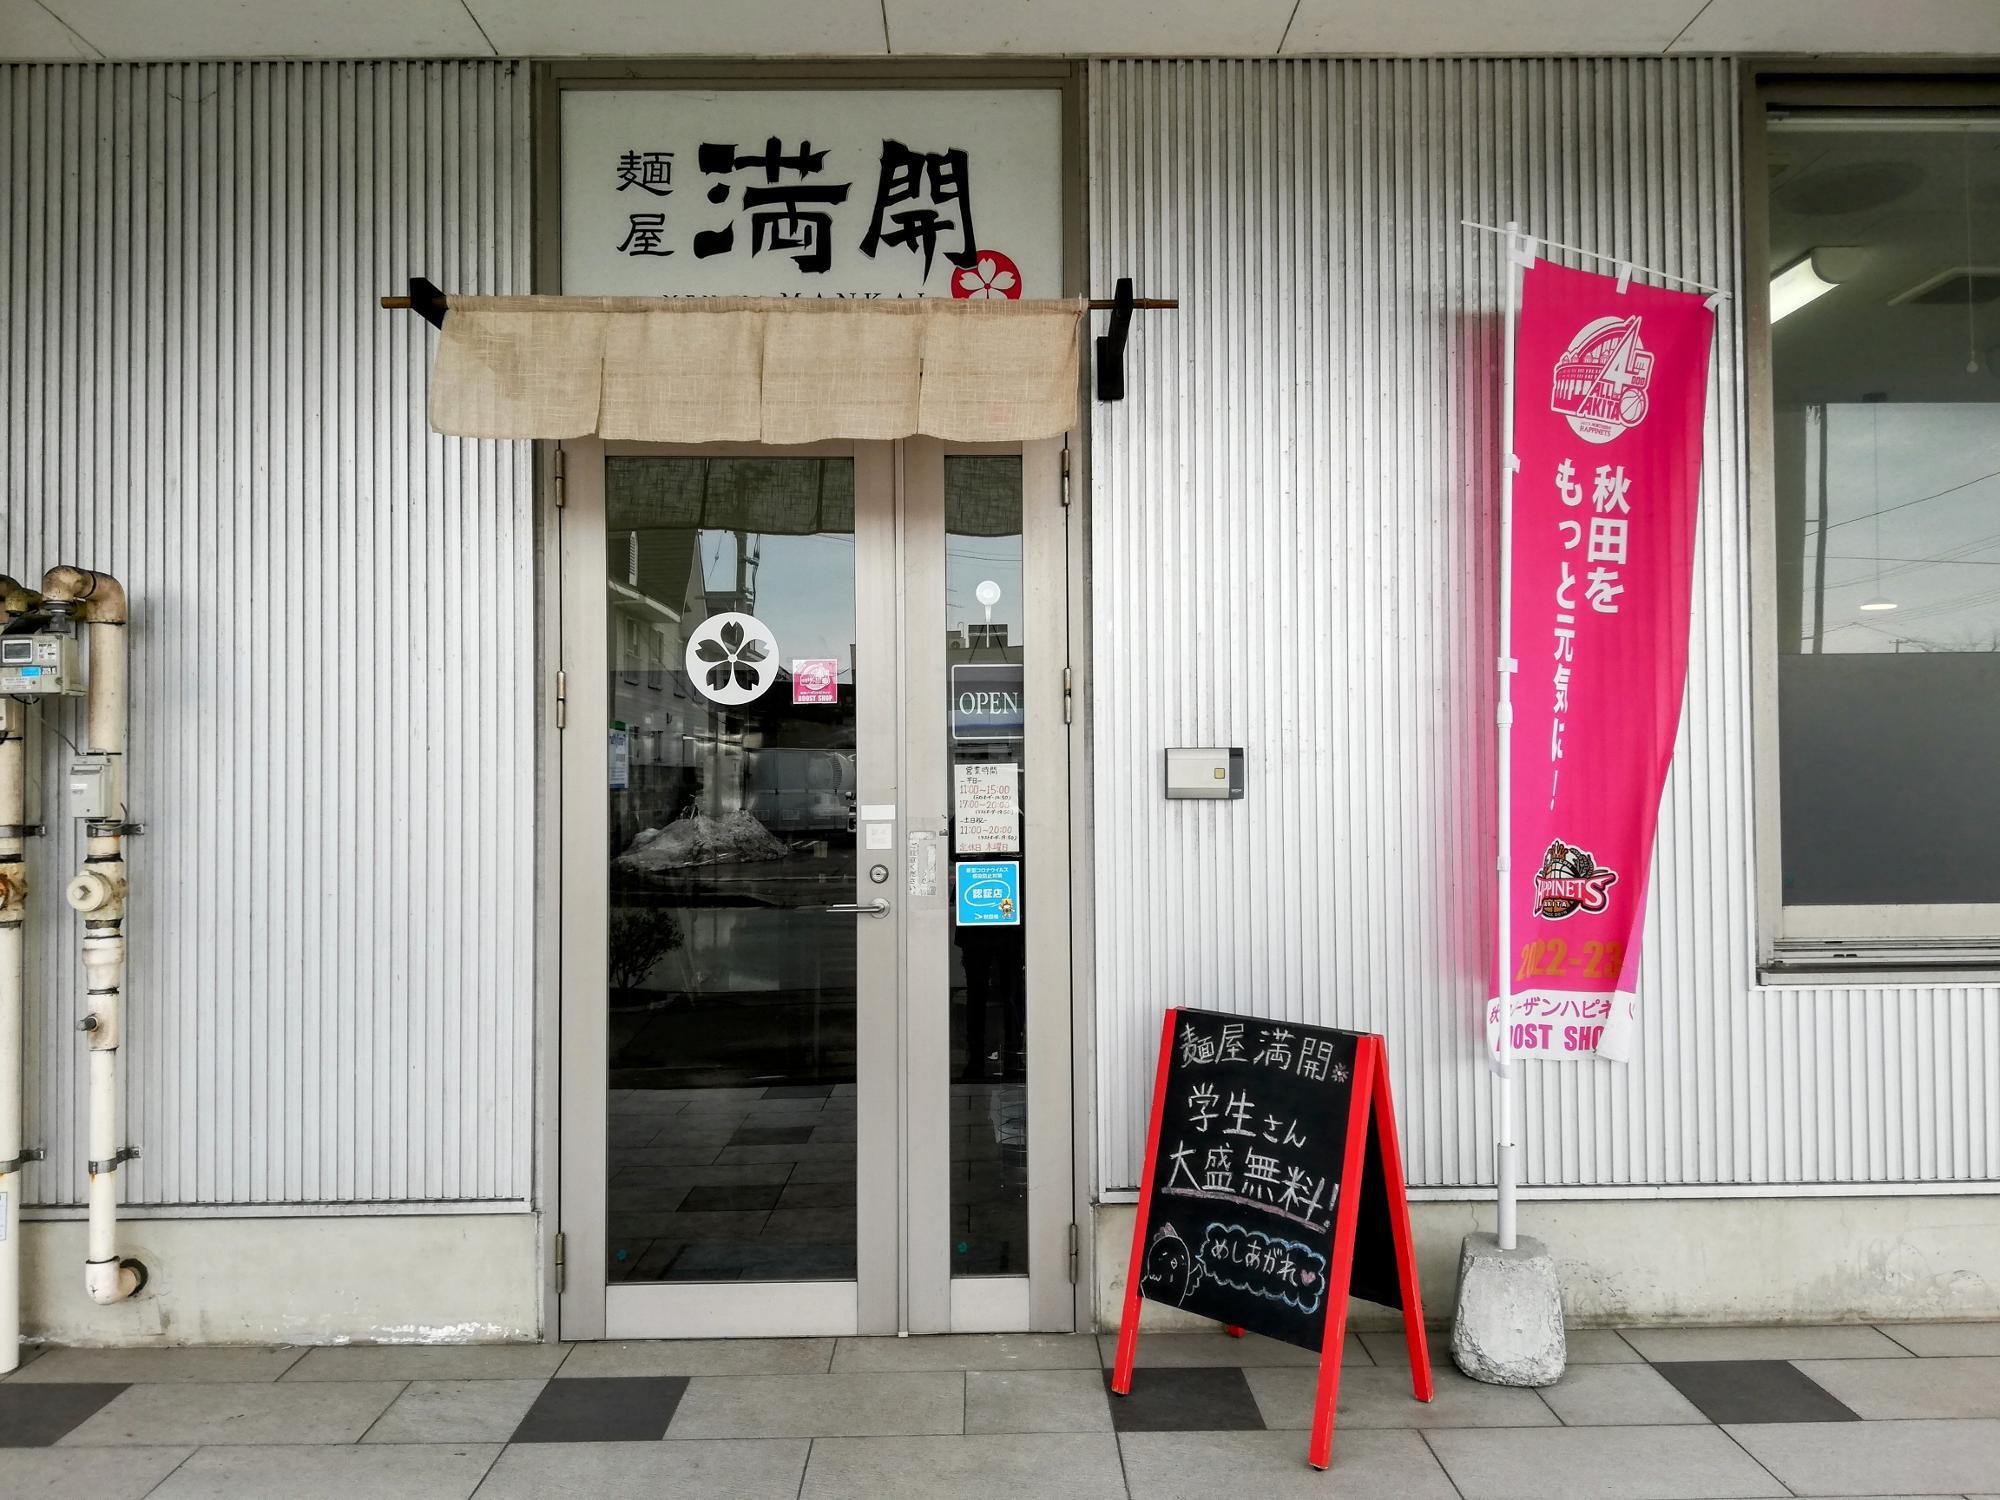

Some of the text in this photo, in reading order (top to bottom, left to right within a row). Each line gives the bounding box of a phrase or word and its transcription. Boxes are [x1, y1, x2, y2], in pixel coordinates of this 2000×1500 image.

[693, 136, 977, 285] 満開
[1580, 398, 1621, 421] AKITA
[1584, 465, 1631, 613] 秋田を
[959, 692, 1018, 715] OPEN
[1564, 1025, 1605, 1053] SHO
[1188, 1082, 1307, 1149] 学生さん
[1169, 1139, 1340, 1228] 大盛無料!
[1211, 1238, 1298, 1287] めしあがれ
